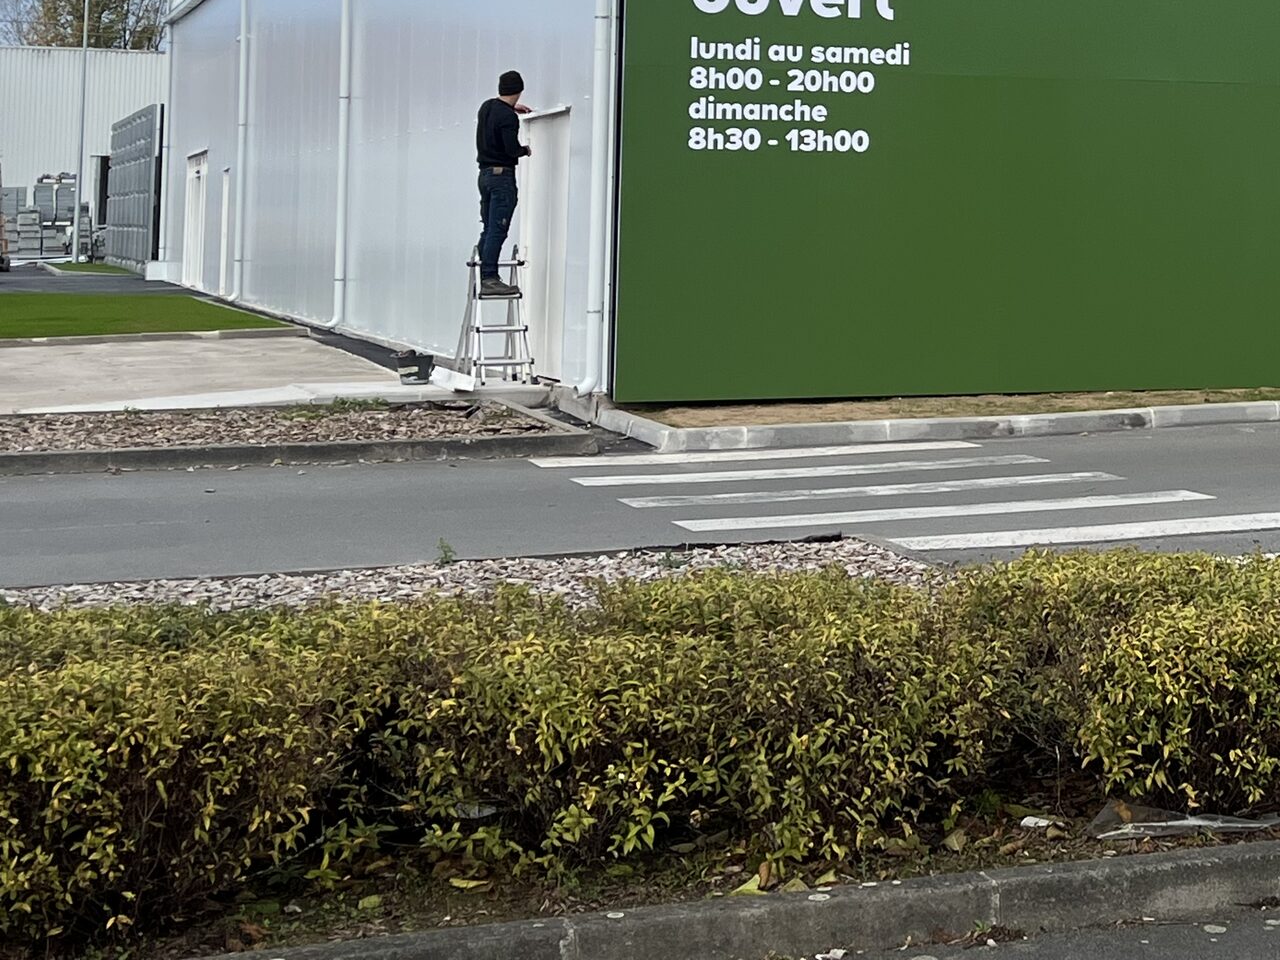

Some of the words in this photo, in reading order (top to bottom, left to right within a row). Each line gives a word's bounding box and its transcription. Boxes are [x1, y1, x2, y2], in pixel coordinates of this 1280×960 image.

[690, 36, 761, 61] lundi
[767, 44, 804, 63] au
[810, 42, 910, 66] samedi
[689, 65, 763, 91] 8h00
[786, 68, 875, 94] 20h00
[688, 95, 828, 122] dimanche
[687, 126, 762, 151] 8h30
[784, 128, 870, 153] 13h00
